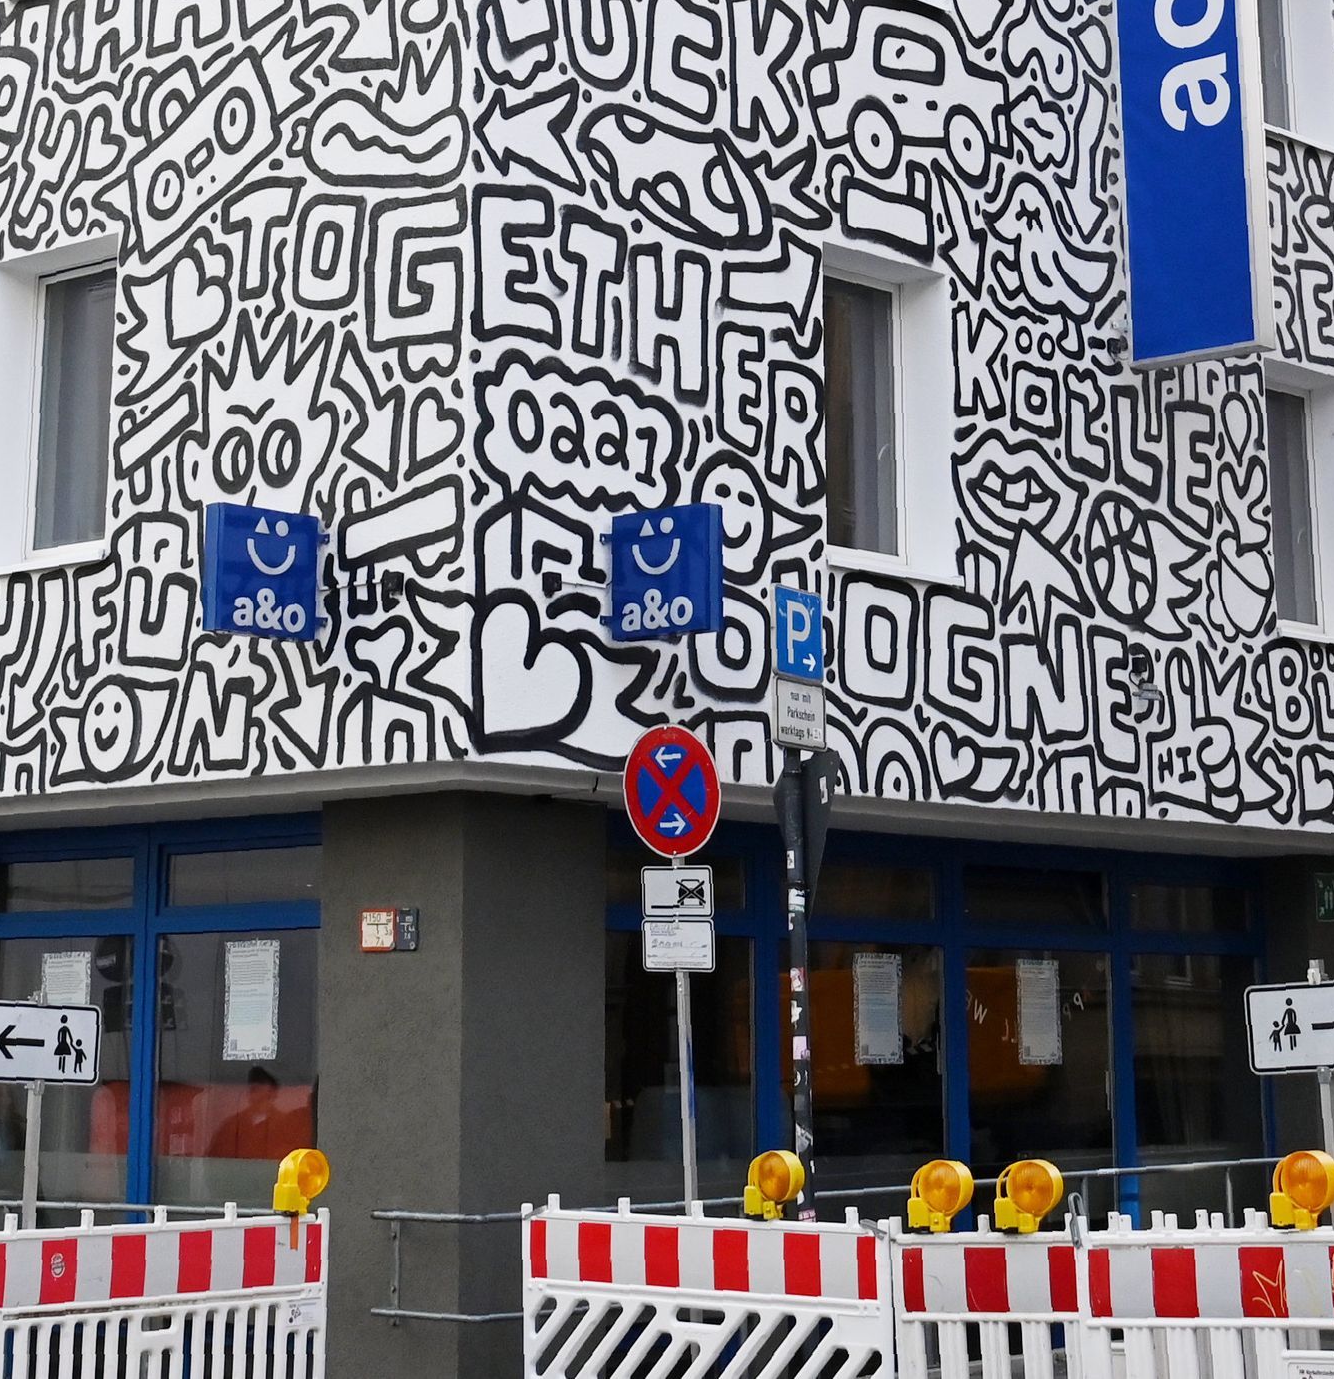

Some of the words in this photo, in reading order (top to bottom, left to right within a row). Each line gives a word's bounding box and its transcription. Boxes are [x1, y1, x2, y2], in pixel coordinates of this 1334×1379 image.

[953, 311, 1214, 540] KÖLLE
[232, 587, 306, 633] a&o
[621, 588, 694, 633] a&o
[787, 599, 812, 665] P
[787, 705, 816, 722] Parkschein
[801, 694, 812, 705] mit
[780, 725, 805, 740] werktags
[1159, 743, 1197, 785] HI
